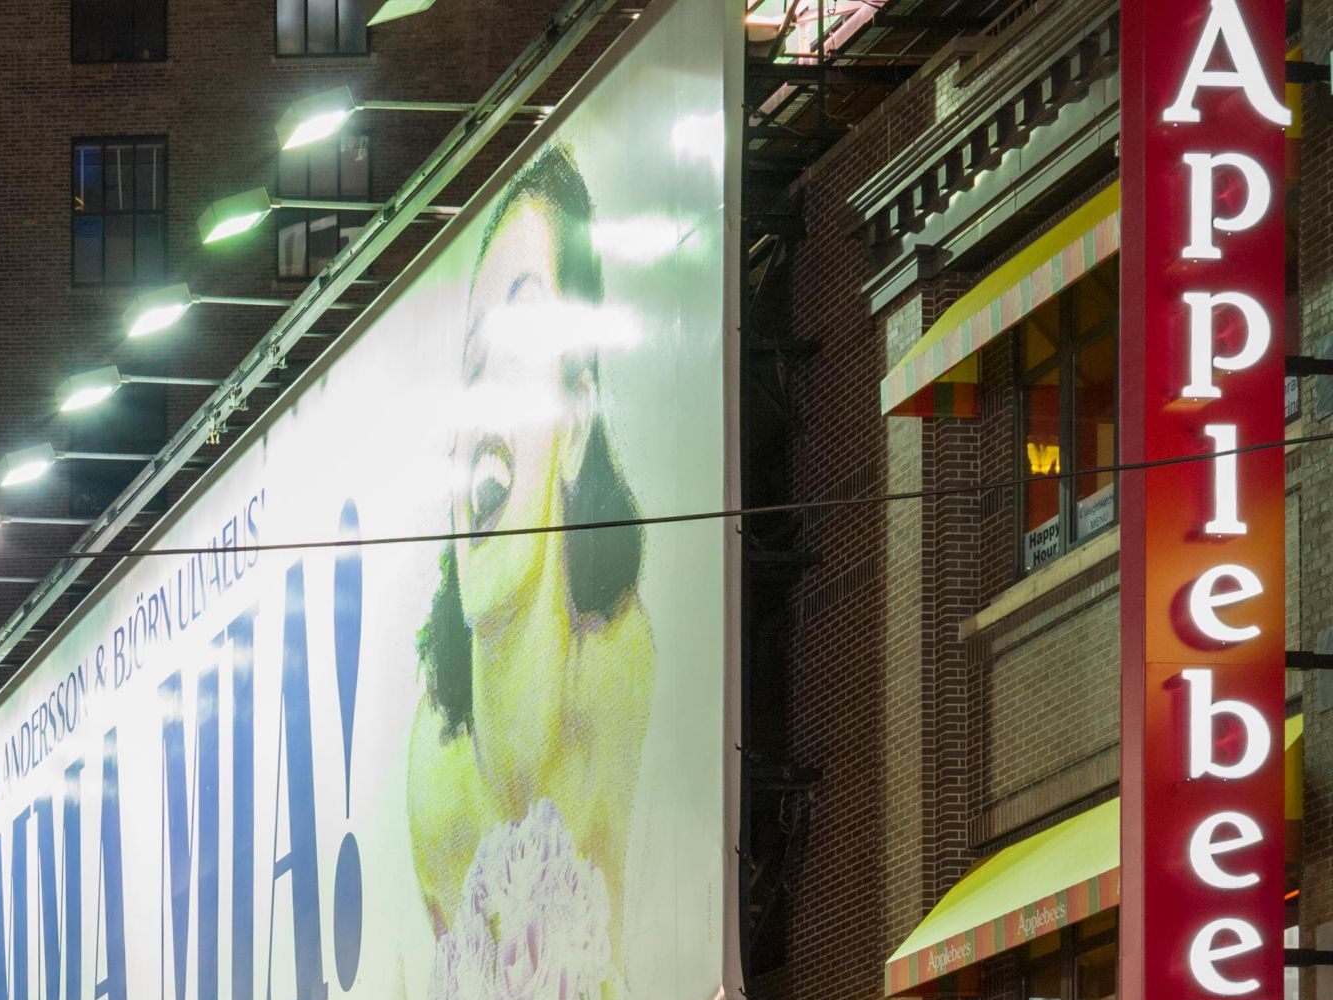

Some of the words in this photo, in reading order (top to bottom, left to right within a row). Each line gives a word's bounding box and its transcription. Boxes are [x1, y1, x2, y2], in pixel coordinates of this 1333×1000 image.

[1029, 523, 1060, 549] Happy
[1034, 543, 1058, 565] Hour
[2, 688, 90, 779] ANDERSSON
[95, 656, 108, 693] &
[113, 594, 173, 692] BJÖRN
[1017, 902, 1066, 935] Applebee's
[927, 940, 971, 971] Applebee's
